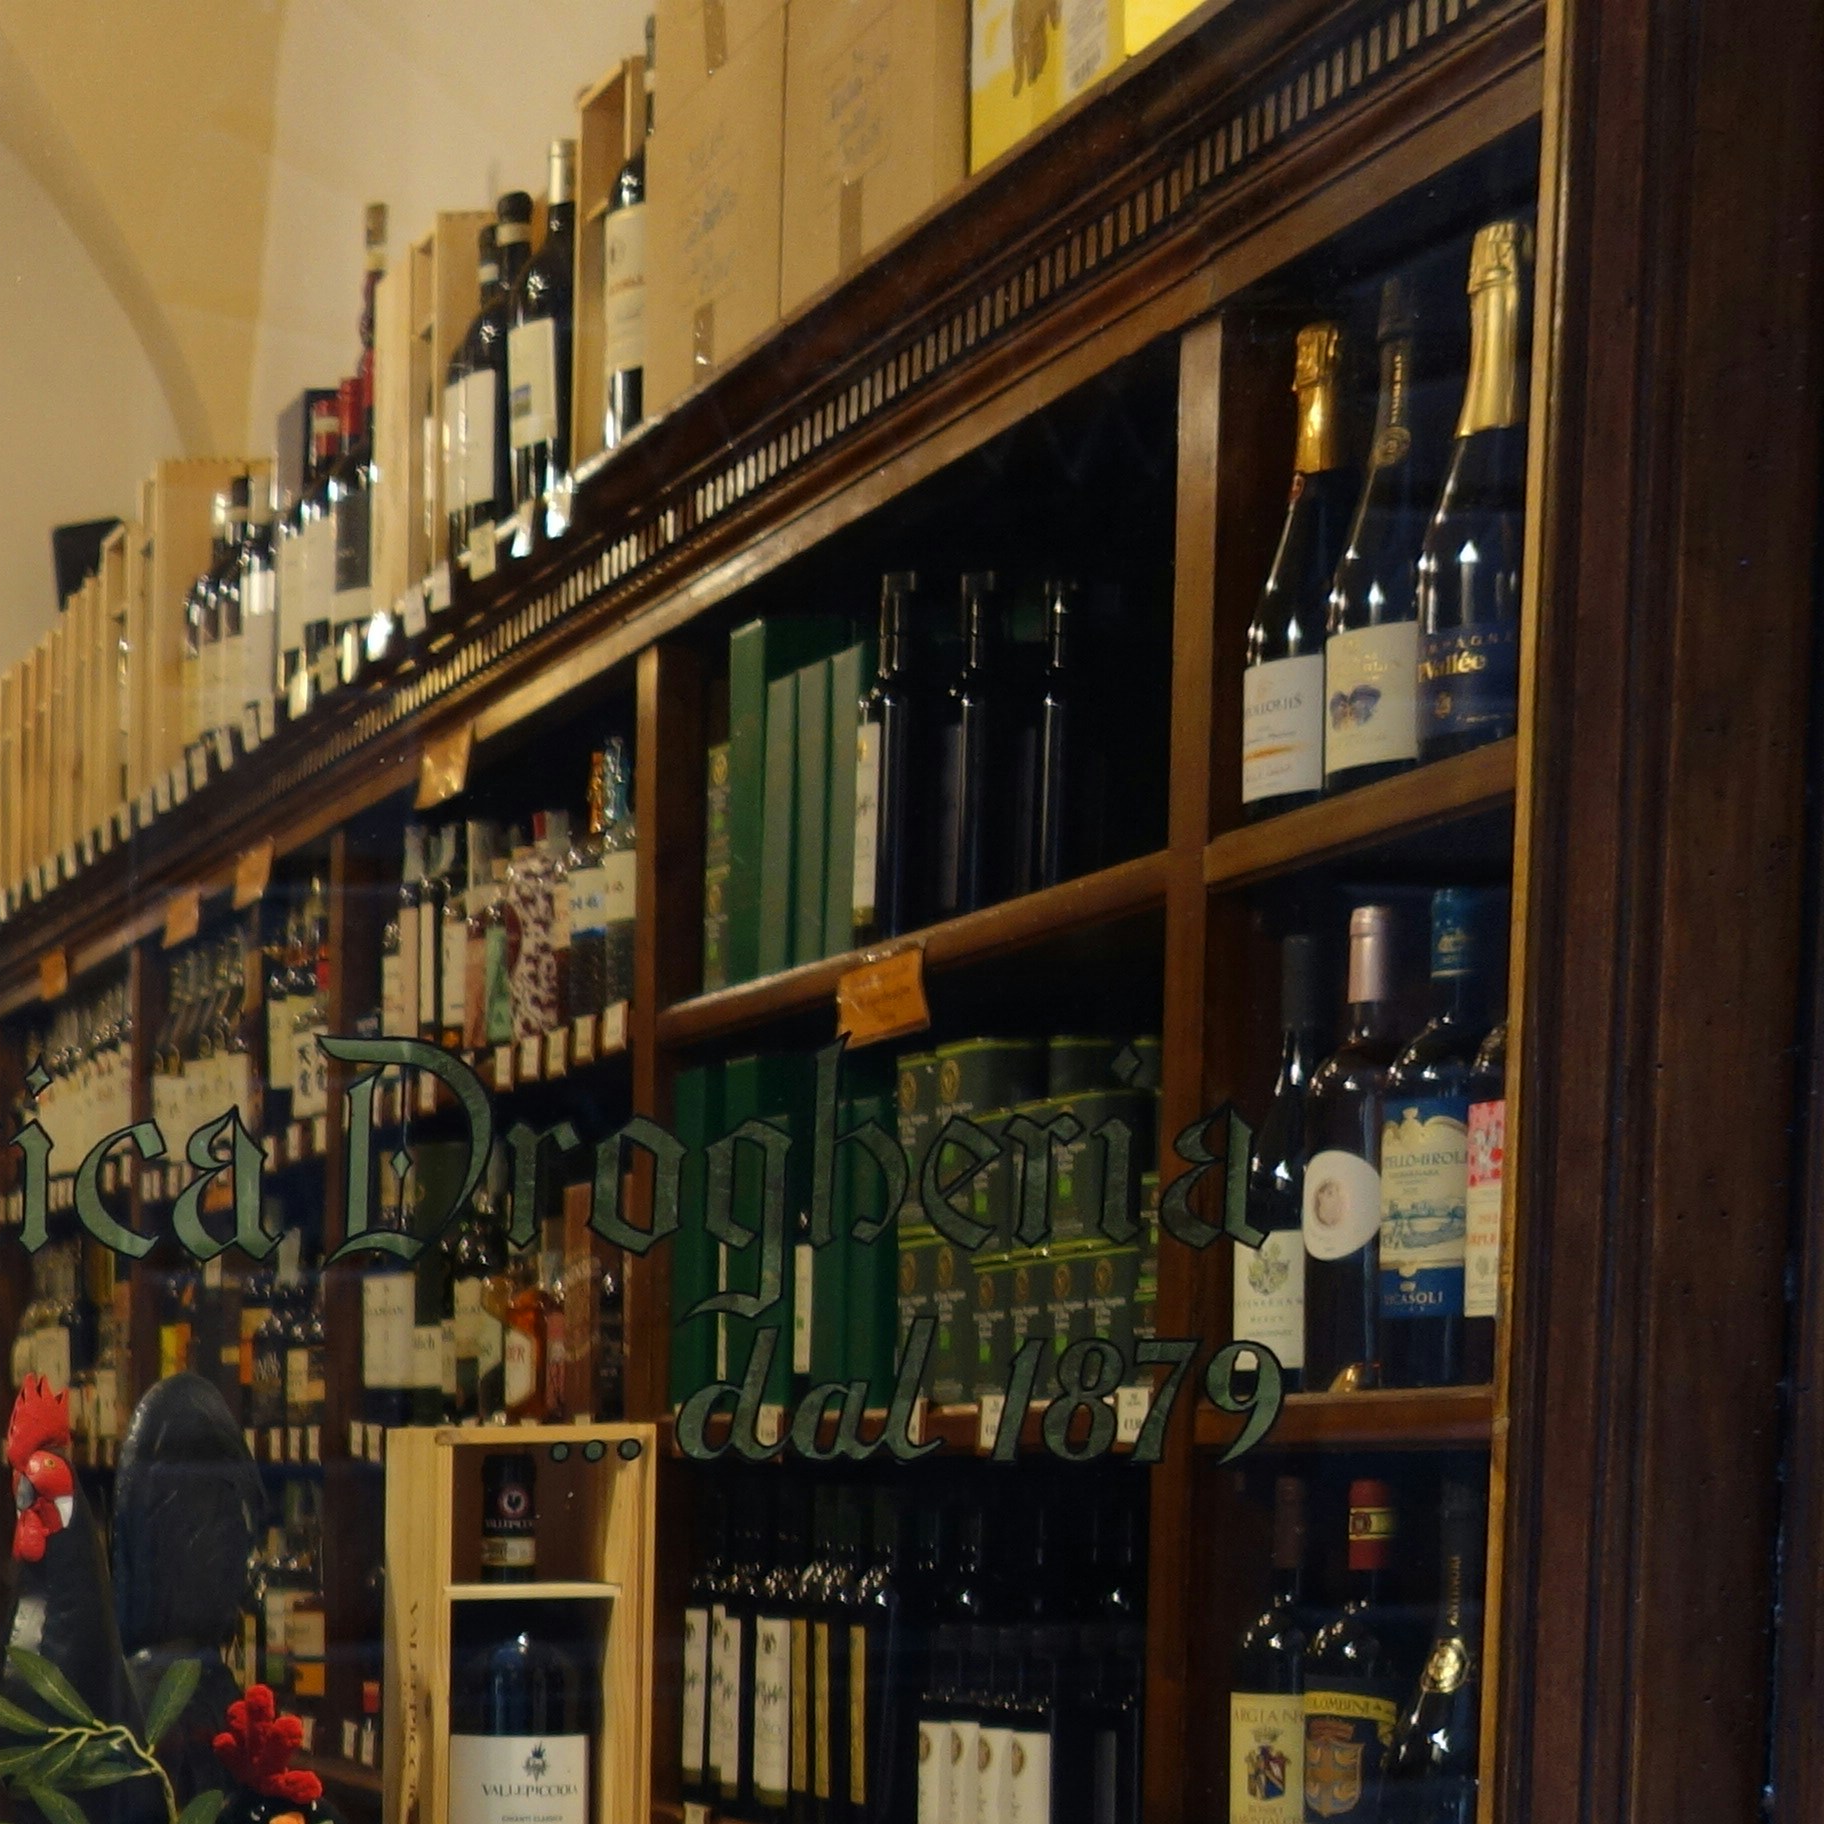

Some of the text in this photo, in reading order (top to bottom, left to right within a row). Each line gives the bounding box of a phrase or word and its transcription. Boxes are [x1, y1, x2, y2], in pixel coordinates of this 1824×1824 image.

[313, 1034, 1273, 1316] Drogheria
[669, 1313, 1286, 1469] dal 1879
[481, 1783, 579, 1800] VALLEPICCIOLA
